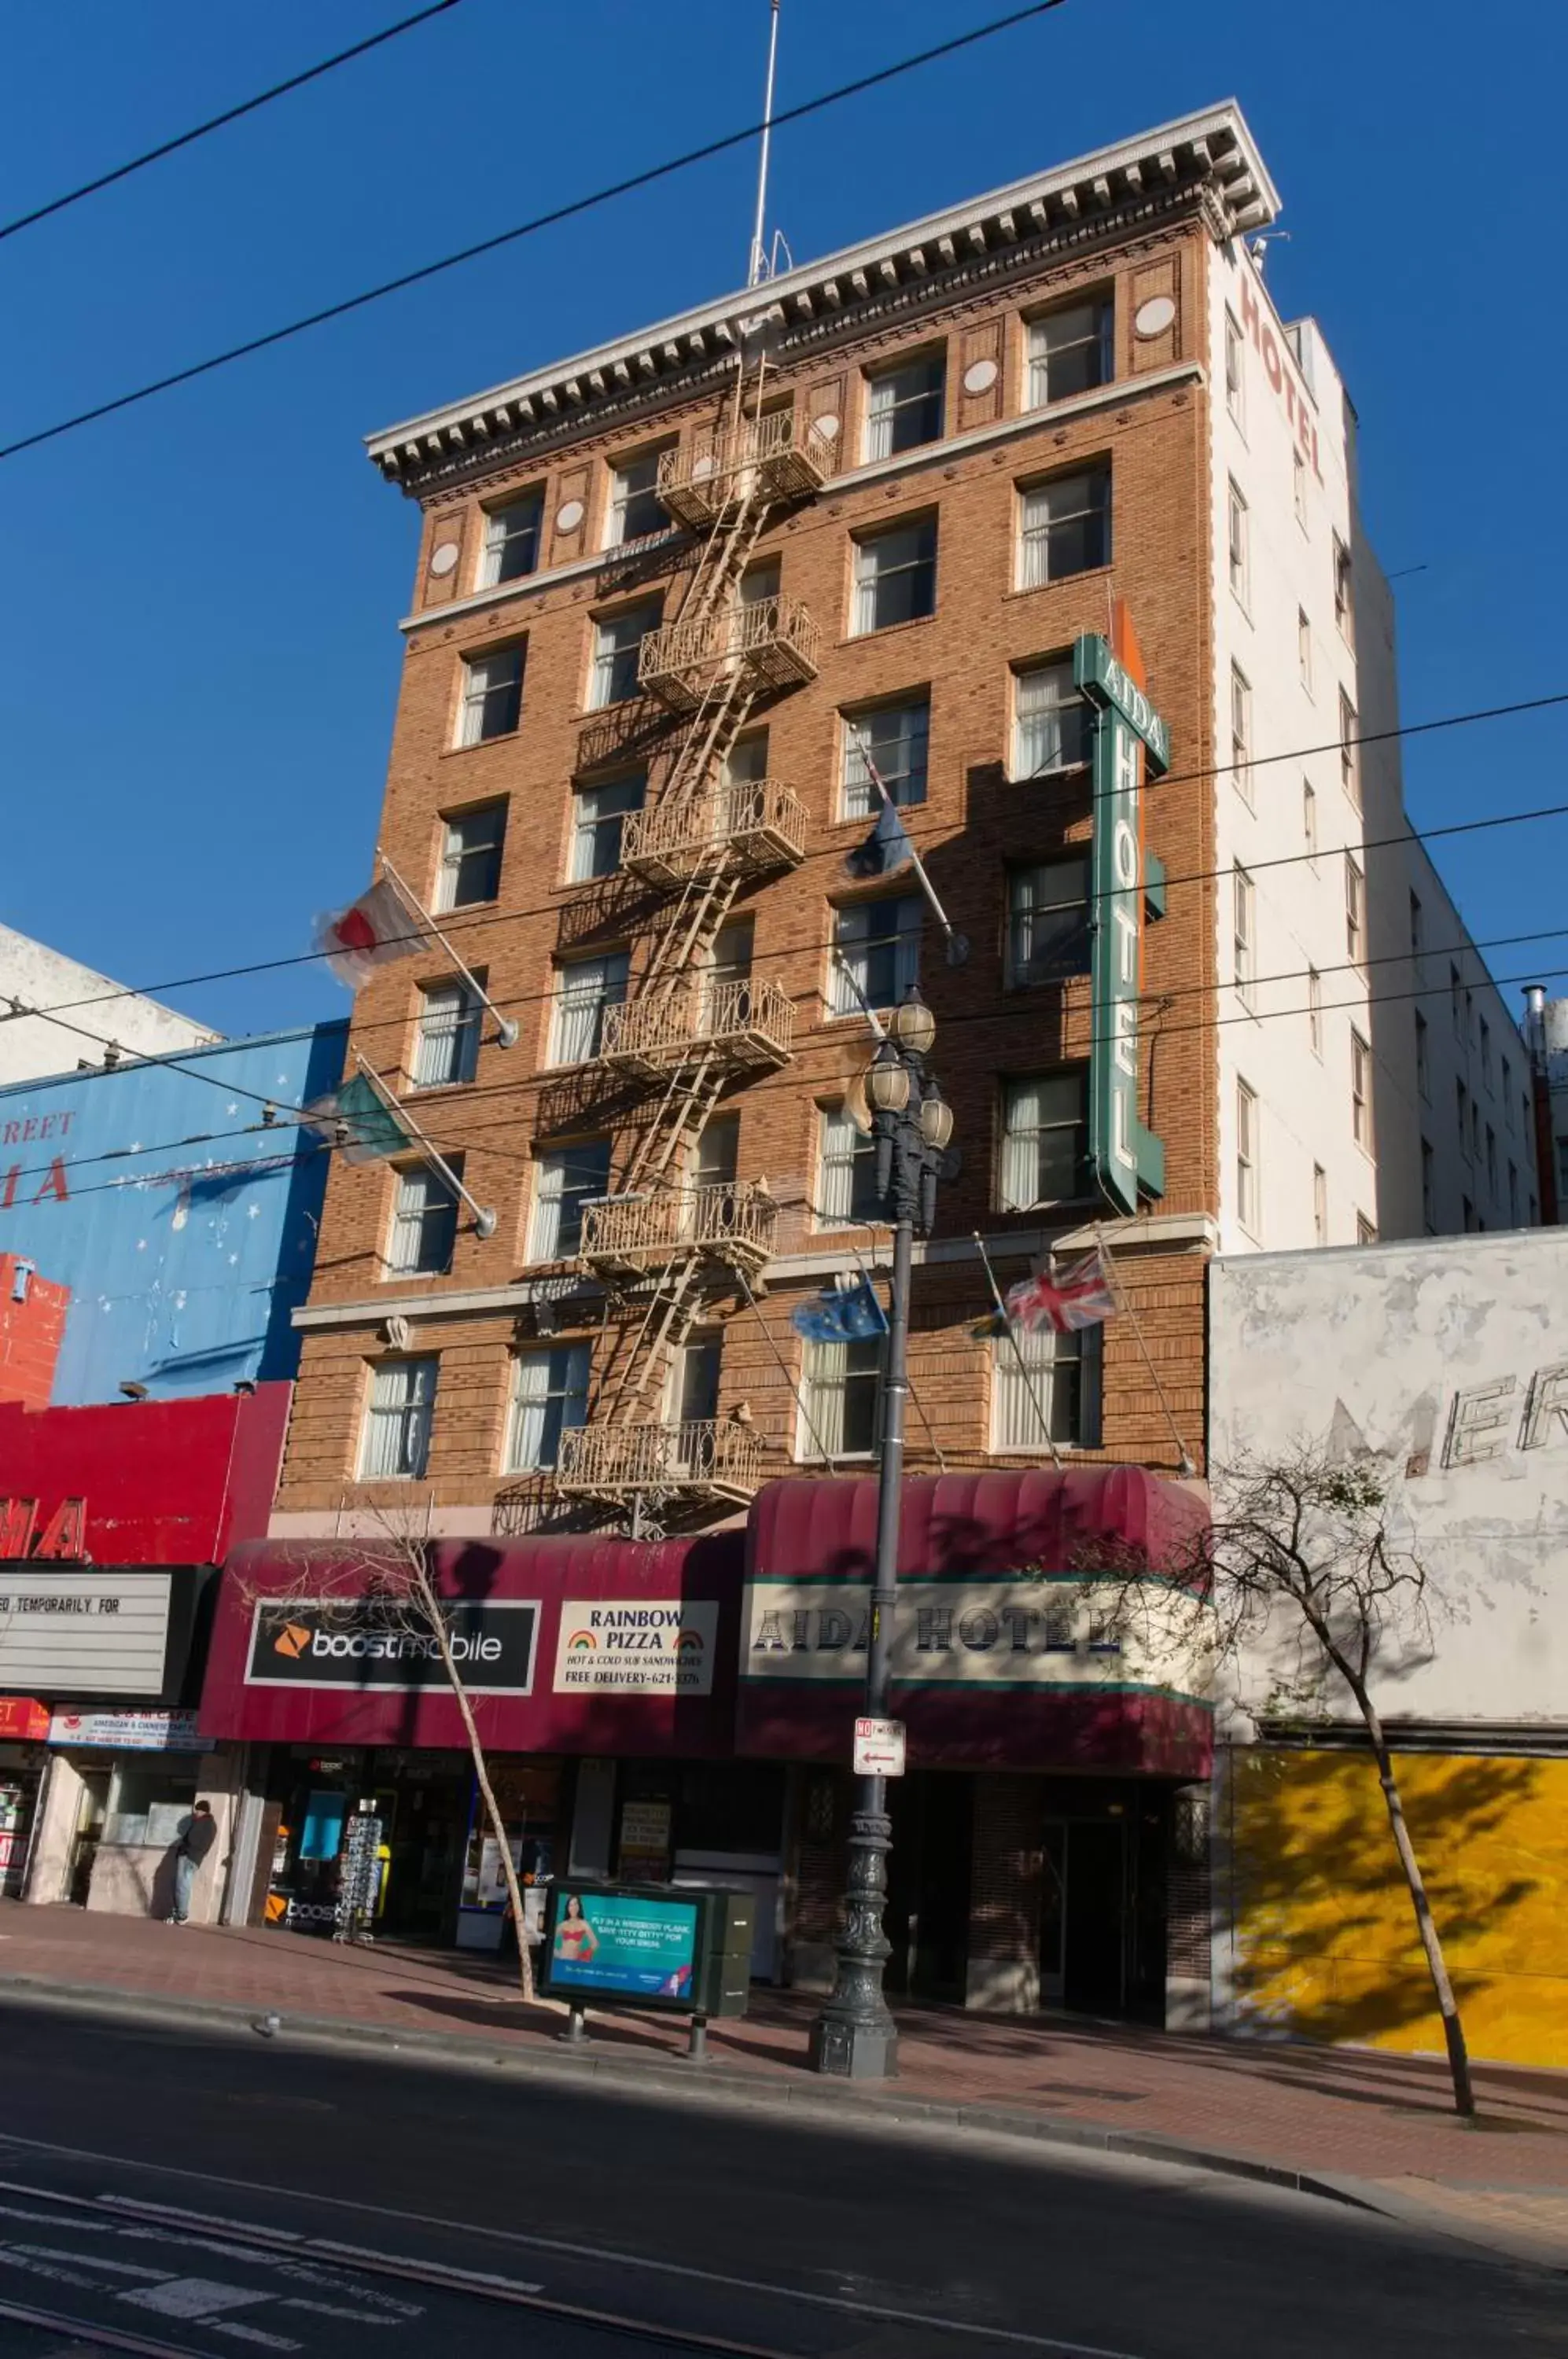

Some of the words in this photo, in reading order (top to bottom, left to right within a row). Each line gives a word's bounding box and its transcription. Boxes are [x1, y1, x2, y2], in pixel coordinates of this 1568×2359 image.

[1239, 272, 1324, 489] HOTEL
[1103, 657, 1164, 760] AIDA
[1113, 723, 1139, 1172] HOTEL
[0, 1110, 76, 1146] REET
[17, 1597, 91, 1613] TEMPORARILY
[99, 1599, 120, 1614] FOR
[591, 1610, 685, 1627] RAINBOW
[606, 1632, 662, 1649] PIZZA
[567, 1655, 586, 1665] HOT
[589, 1655, 594, 1665] &
[597, 1655, 621, 1665] COLD
[565, 1671, 591, 1683] FREE
